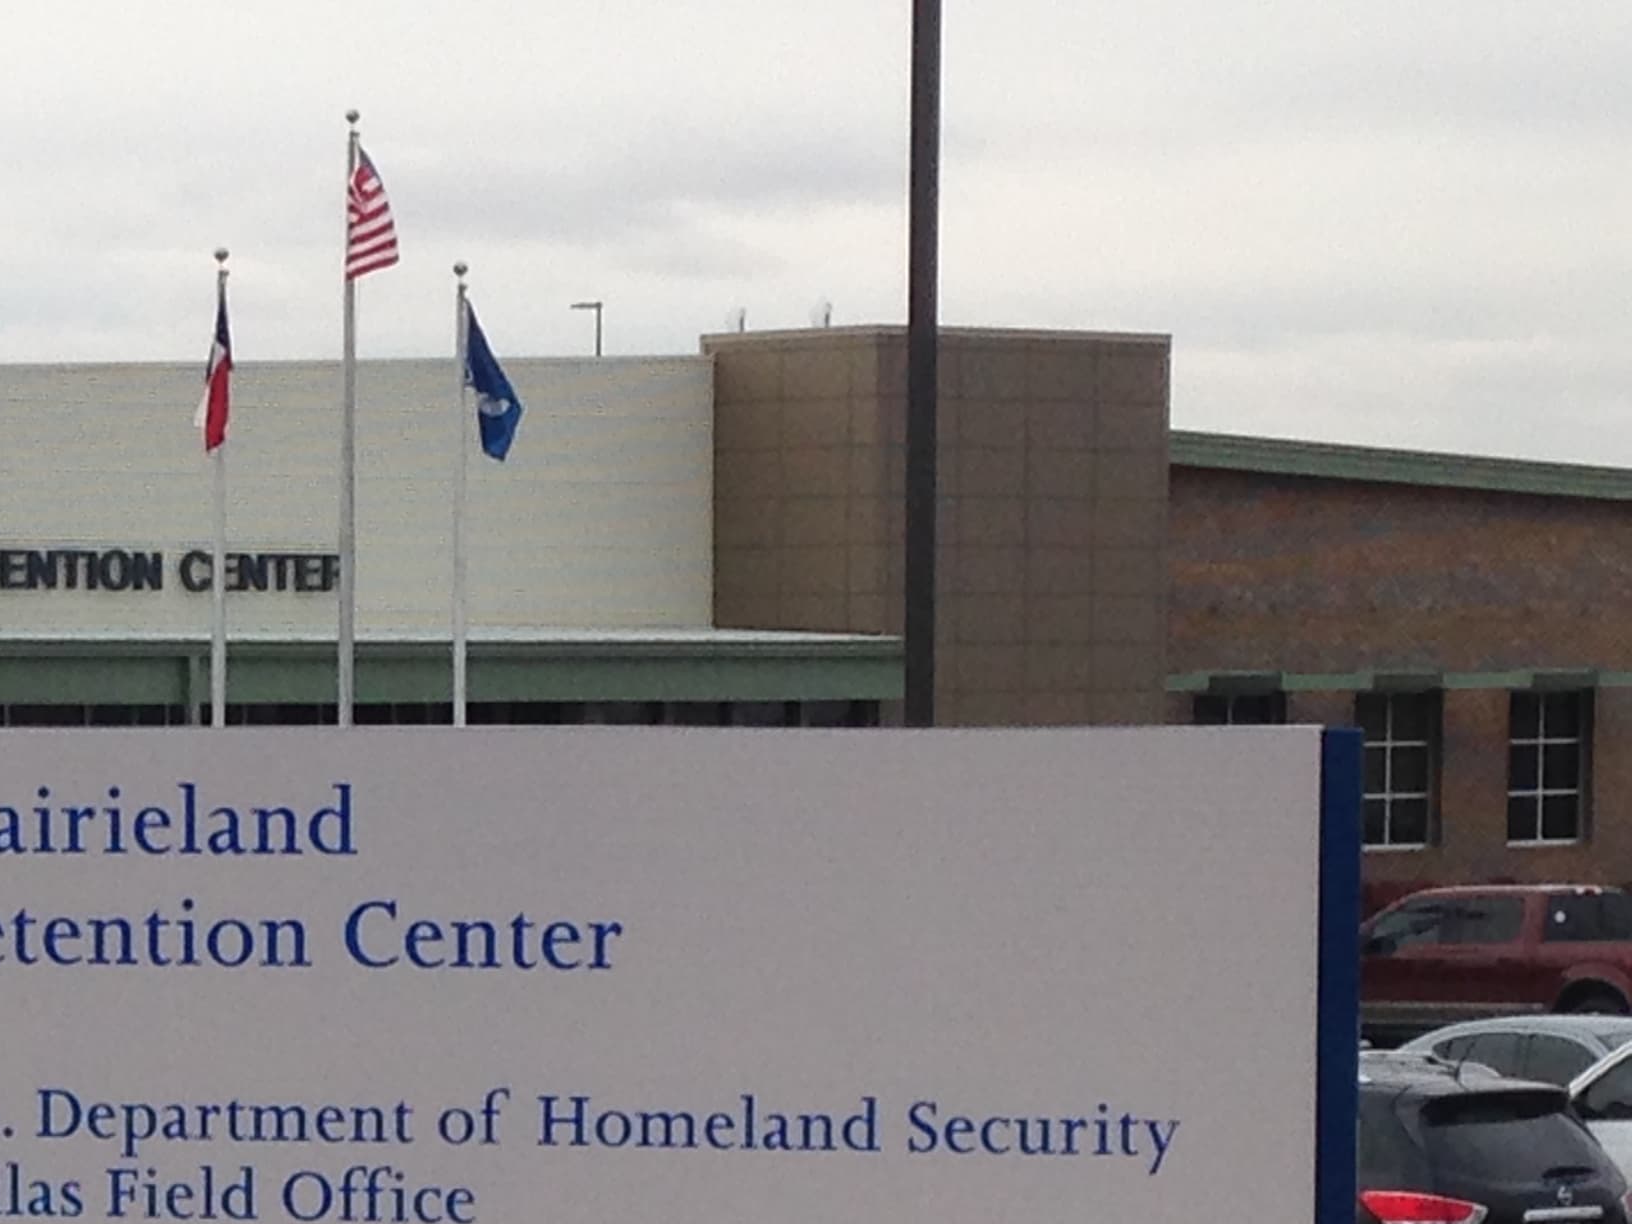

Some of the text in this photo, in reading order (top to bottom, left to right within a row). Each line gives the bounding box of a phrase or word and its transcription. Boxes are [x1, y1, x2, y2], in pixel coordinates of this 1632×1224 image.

[344, 900, 623, 970] Center
[36, 1089, 414, 1158] Department
[438, 1087, 510, 1144] of
[537, 1094, 881, 1153] Homeland
[908, 1101, 1180, 1175] Security
[106, 1165, 257, 1220] Field
[282, 1165, 476, 1224] Office
